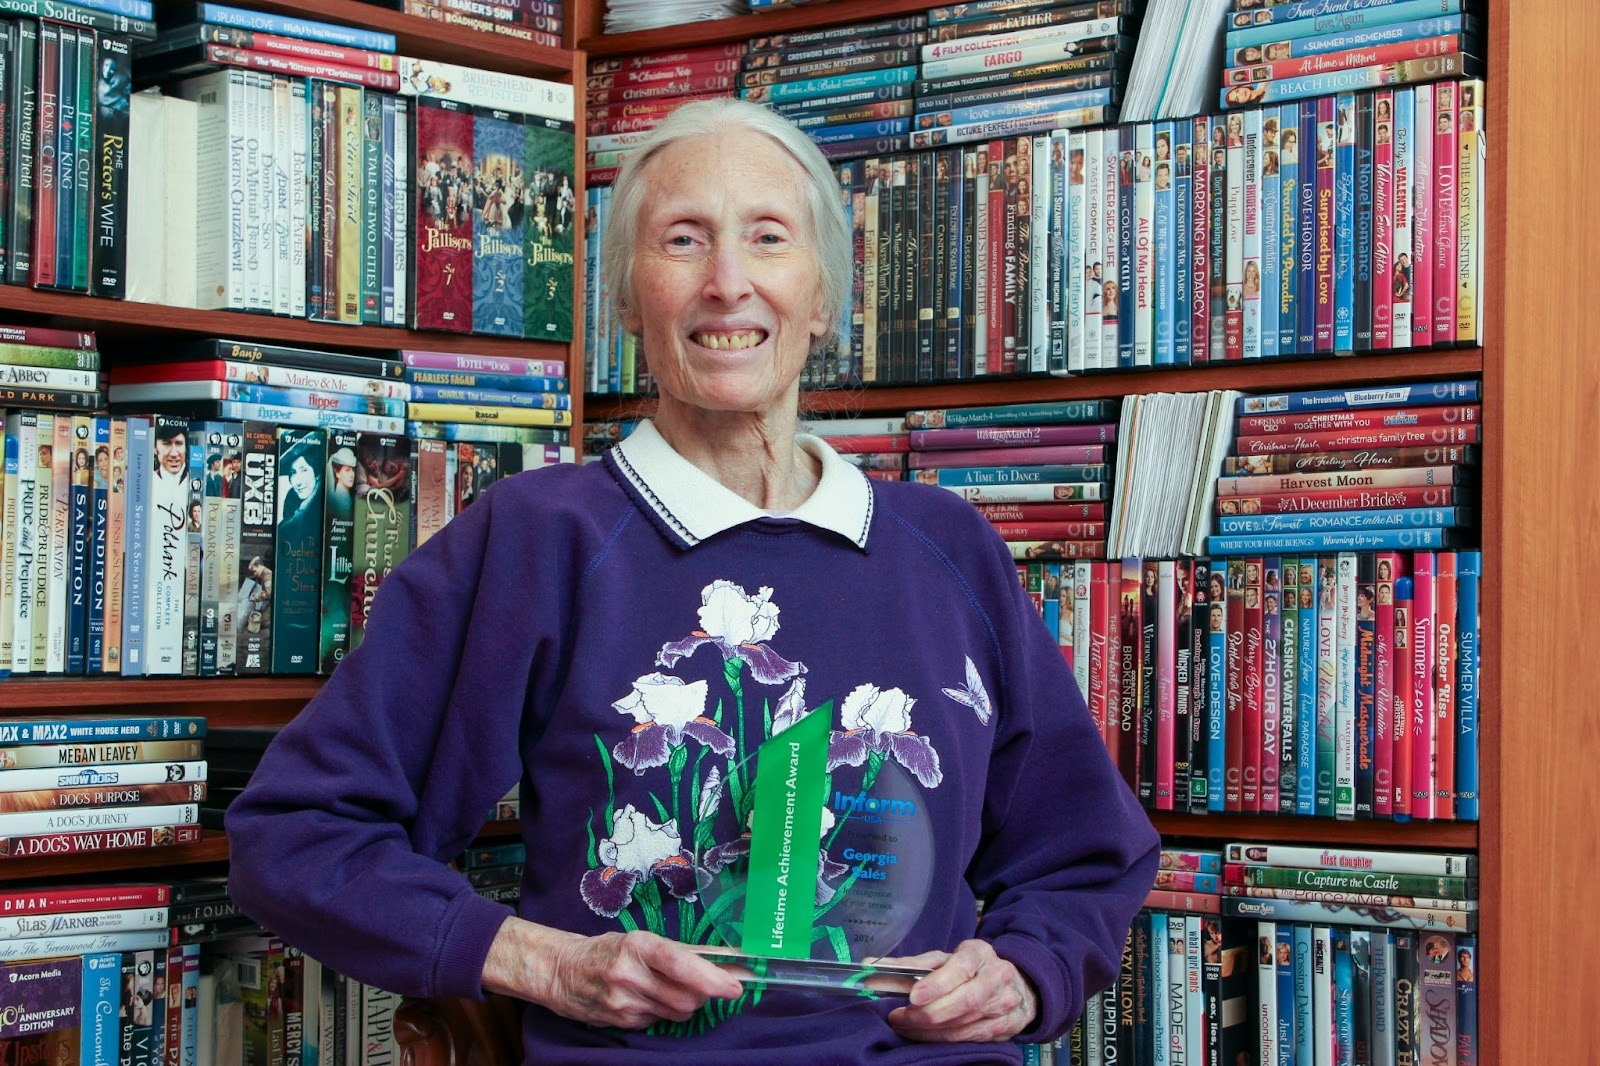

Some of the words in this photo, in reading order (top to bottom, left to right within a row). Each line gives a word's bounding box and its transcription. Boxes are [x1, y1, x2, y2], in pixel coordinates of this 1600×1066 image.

[44, 2, 96, 26] Soldier
[1005, 12, 1053, 30] FATHER
[931, 46, 941, 58] 4
[942, 45, 963, 56] FILM
[964, 36, 1020, 52] COLLECTION
[1308, 41, 1345, 52] SUMMER
[1355, 28, 1403, 44] REMEMBER
[983, 50, 1023, 67] FARGO
[1280, 80, 1322, 96] BEACH
[20, 99, 36, 151] Foreign
[312, 126, 323, 158] Great
[367, 143, 377, 152] A
[1245, 133, 1257, 183] Undercover
[1358, 148, 1371, 158] A
[20, 155, 34, 188] Field
[61, 153, 74, 193] KING
[367, 155, 378, 188] TALE
[1461, 153, 1471, 173] THE
[311, 160, 323, 231] Expectations
[368, 190, 377, 206] OF
[1106, 155, 1118, 210] SWEETER
[1301, 182, 1313, 212] LOVE
[1358, 160, 1369, 203] Novel
[1396, 166, 1408, 229] VALENTINE
[1460, 176, 1471, 207] LOST
[368, 207, 378, 235] TWO
[1106, 211, 1117, 233] SIDE
[1177, 183, 1189, 244] UNLEASHING
[1192, 168, 1206, 243] MARRYING
[1245, 184, 1257, 236] BRIDESMAID
[1283, 177, 1297, 236] Stranded
[1317, 188, 1332, 250] Surprised
[100, 203, 116, 248] WIFE
[421, 225, 473, 253] Pallisers
[1006, 203, 1016, 249] Finding
[1072, 195, 1084, 252] Sundays
[1090, 202, 1100, 256] ROMANCE
[1121, 208, 1130, 247] COLOR
[1137, 216, 1150, 235] All
[474, 233, 525, 258] Pallisers
[528, 241, 575, 267] Pallisers
[1105, 244, 1117, 269] LIFE
[1138, 237, 1150, 253] Of
[1192, 245, 1205, 269] MR.
[1300, 222, 1313, 273] HONOR
[1318, 250, 1330, 272] by
[1358, 209, 1370, 282] Romance
[1459, 210, 1471, 280] VALENTINE
[366, 238, 378, 289] CITIES
[1138, 254, 1150, 273] My
[1004, 256, 1017, 305] FAMILY
[1137, 275, 1149, 310] Heart
[1176, 267, 1188, 303] DARCY
[1192, 270, 1206, 320] DARCY
[1317, 274, 1330, 306] Love
[230, 344, 263, 363] Banjo
[456, 356, 483, 371] HOTEL
[413, 371, 448, 385] FEARLESS
[450, 375, 476, 387] FAGAN
[1353, 390, 1386, 403] Blueberry
[1386, 388, 1402, 398] Farm
[21, 391, 55, 401] PARK
[1293, 420, 1333, 431] TOGETHER
[1311, 414, 1356, 423] CHRISTMAS
[1333, 420, 1352, 428] WITH
[1353, 419, 1372, 428] YOU
[1336, 432, 1379, 446] christmas
[1379, 430, 1407, 445] family
[243, 453, 263, 526] UXB
[263, 454, 276, 526] DANGER
[965, 473, 972, 484] A
[973, 471, 994, 483] TIME
[996, 471, 1009, 482] TO
[1011, 471, 1041, 482] DANCE
[1279, 478, 1333, 490] Harvest
[1336, 474, 1375, 486] Moon
[20, 477, 36, 525] PRIDE
[1288, 497, 1299, 511] A
[1300, 493, 1358, 510] December
[1359, 490, 1397, 507] Bride
[984, 512, 1024, 523] CHRISTMAS
[1222, 521, 1253, 532] LOVE
[1309, 516, 1362, 528] ROMANCE
[1386, 514, 1405, 526] AIR
[73, 493, 87, 606] SANDITON
[94, 498, 107, 612] SANDITON
[331, 547, 352, 585] Lillie
[19, 552, 34, 620] Prejudice
[1280, 618, 1295, 677] CHASING
[1319, 616, 1333, 657] LOVE
[1413, 617, 1431, 679] Summer
[1437, 623, 1453, 681] October
[1122, 645, 1132, 694] BROKEN
[1177, 648, 1190, 682] WICKED
[1212, 646, 1223, 681] LOVE
[1356, 626, 1374, 686] Midnight
[1460, 631, 1475, 690] SUMMER
[1121, 697, 1132, 732] ROAD
[1176, 684, 1189, 715] MINDS
[1211, 690, 1222, 740] DESIGN
[1437, 682, 1453, 719] Kiss
[1459, 693, 1474, 735] VILLA
[69, 726, 94, 737] WHITE
[95, 726, 119, 736] HOUSE
[121, 725, 141, 735] HERO
[1263, 718, 1276, 756] DAY
[1279, 680, 1293, 763] WATERFALLS
[1355, 688, 1373, 772] Masquerade
[58, 748, 97, 764] MEGAN
[99, 745, 139, 761] LEAVEY
[786, 741, 800, 791] Award
[58, 774, 90, 787] SNOW
[91, 771, 119, 785] DOGS
[59, 793, 91, 806] DOG'S
[94, 790, 140, 803] PURPOSE
[833, 791, 916, 817] Inform
[47, 818, 56, 827] A
[87, 813, 131, 826] JOURNEY
[14, 840, 26, 856] A
[29, 838, 71, 855] DOG'S
[73, 837, 103, 851] WAY
[105, 831, 148, 848] HOME
[776, 790, 795, 887] Achievement
[843, 847, 899, 867] Georgia
[1340, 856, 1373, 869] daughter
[1297, 870, 1302, 884] I
[1304, 870, 1348, 889] Capture
[1349, 875, 1363, 888] the
[1363, 875, 1400, 890] Castle
[770, 889, 787, 950] Lifetime
[18, 972, 40, 982] Acorn
[41, 969, 62, 980] Media
[1295, 940, 1309, 992] Crossing
[1188, 973, 1198, 993] wants
[19, 1019, 54, 1032] EDITION
[20, 1006, 76, 1022] ANNIVERSARY
[1121, 992, 1134, 1027] LOVE
[1170, 983, 1184, 1036] MADE
[1395, 978, 1413, 1045] CRAZY
[286, 1012, 304, 1053] MERCY
